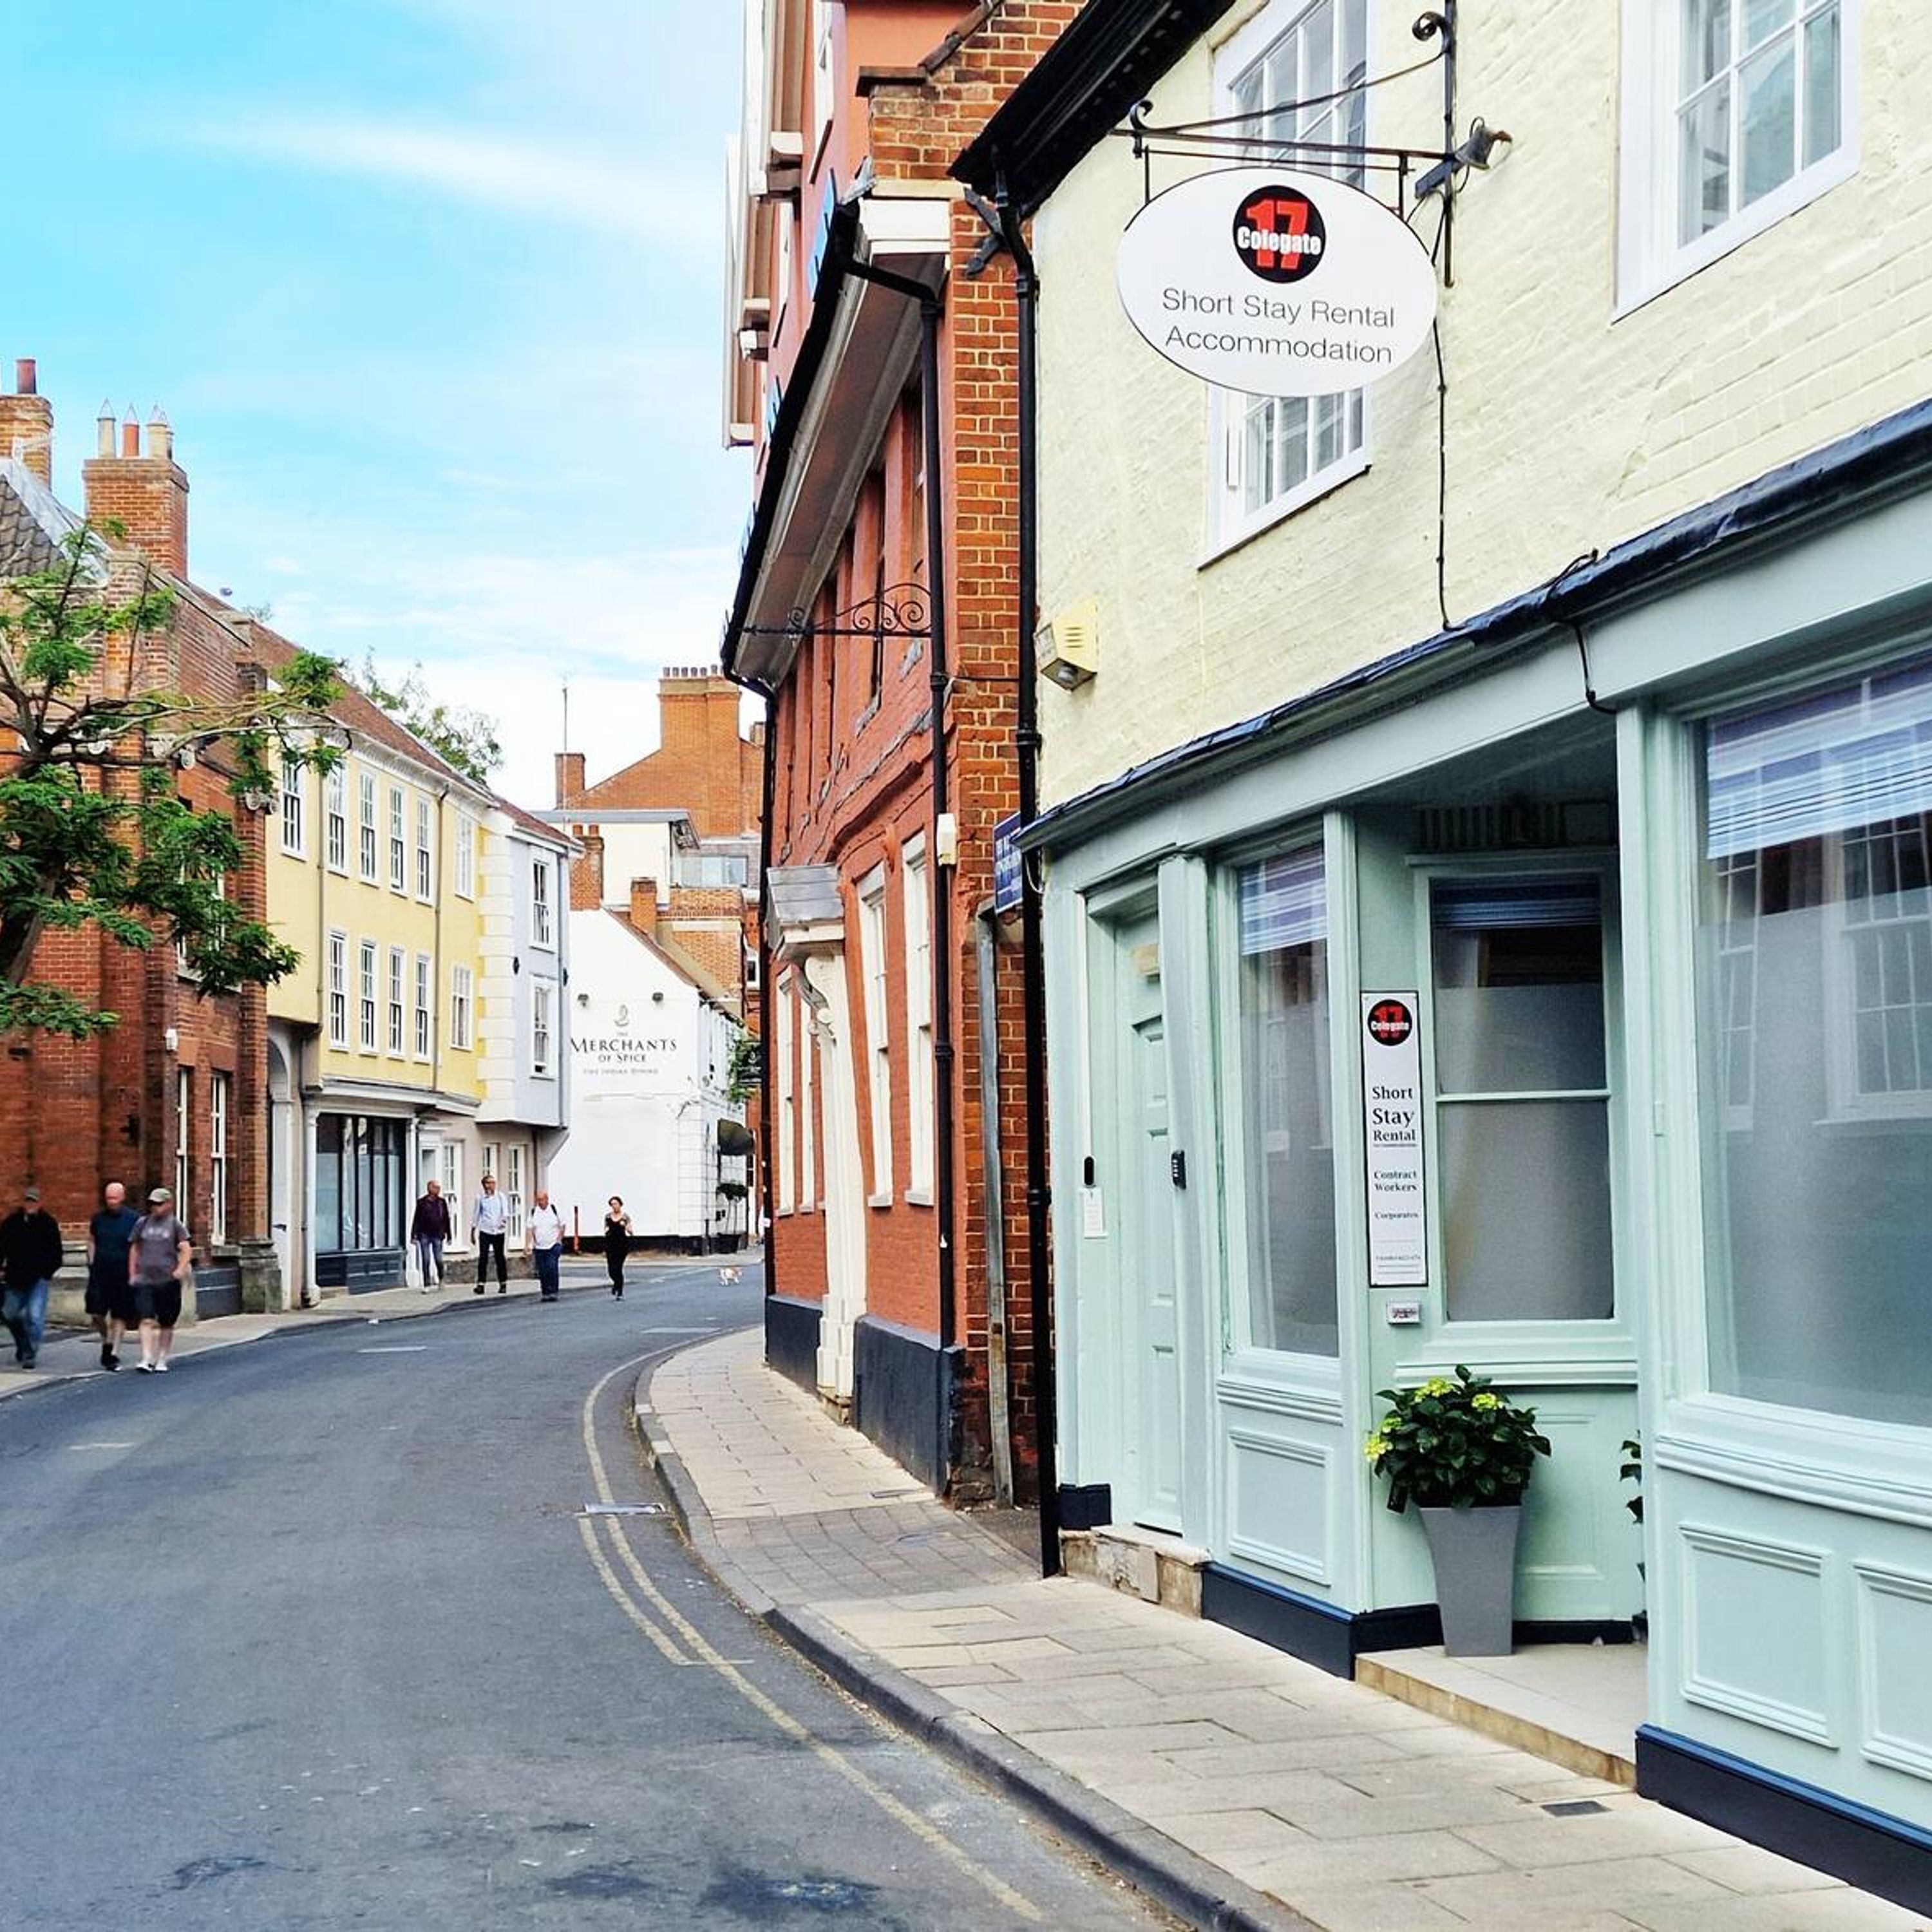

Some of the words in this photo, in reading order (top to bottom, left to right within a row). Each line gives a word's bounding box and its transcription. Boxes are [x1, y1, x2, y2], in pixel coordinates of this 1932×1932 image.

[1237, 225, 1321, 255] Colegate
[1246, 199, 1308, 269] 17
[1162, 288, 1233, 316] Short
[1244, 295, 1302, 325] Stay
[1311, 299, 1395, 328] Rental
[1165, 325, 1392, 364] Accommodation
[1374, 1006, 1403, 1038] 17
[571, 1037, 677, 1053] MERCHANTS
[598, 1054, 611, 1063] OF
[616, 1053, 647, 1063] SPICE
[1372, 1085, 1413, 1100] Short
[1372, 1108, 1414, 1128] Stay
[1373, 1129, 1416, 1142] Rental
[1374, 1170, 1416, 1180] Contract
[1374, 1183, 1417, 1192] Workers
